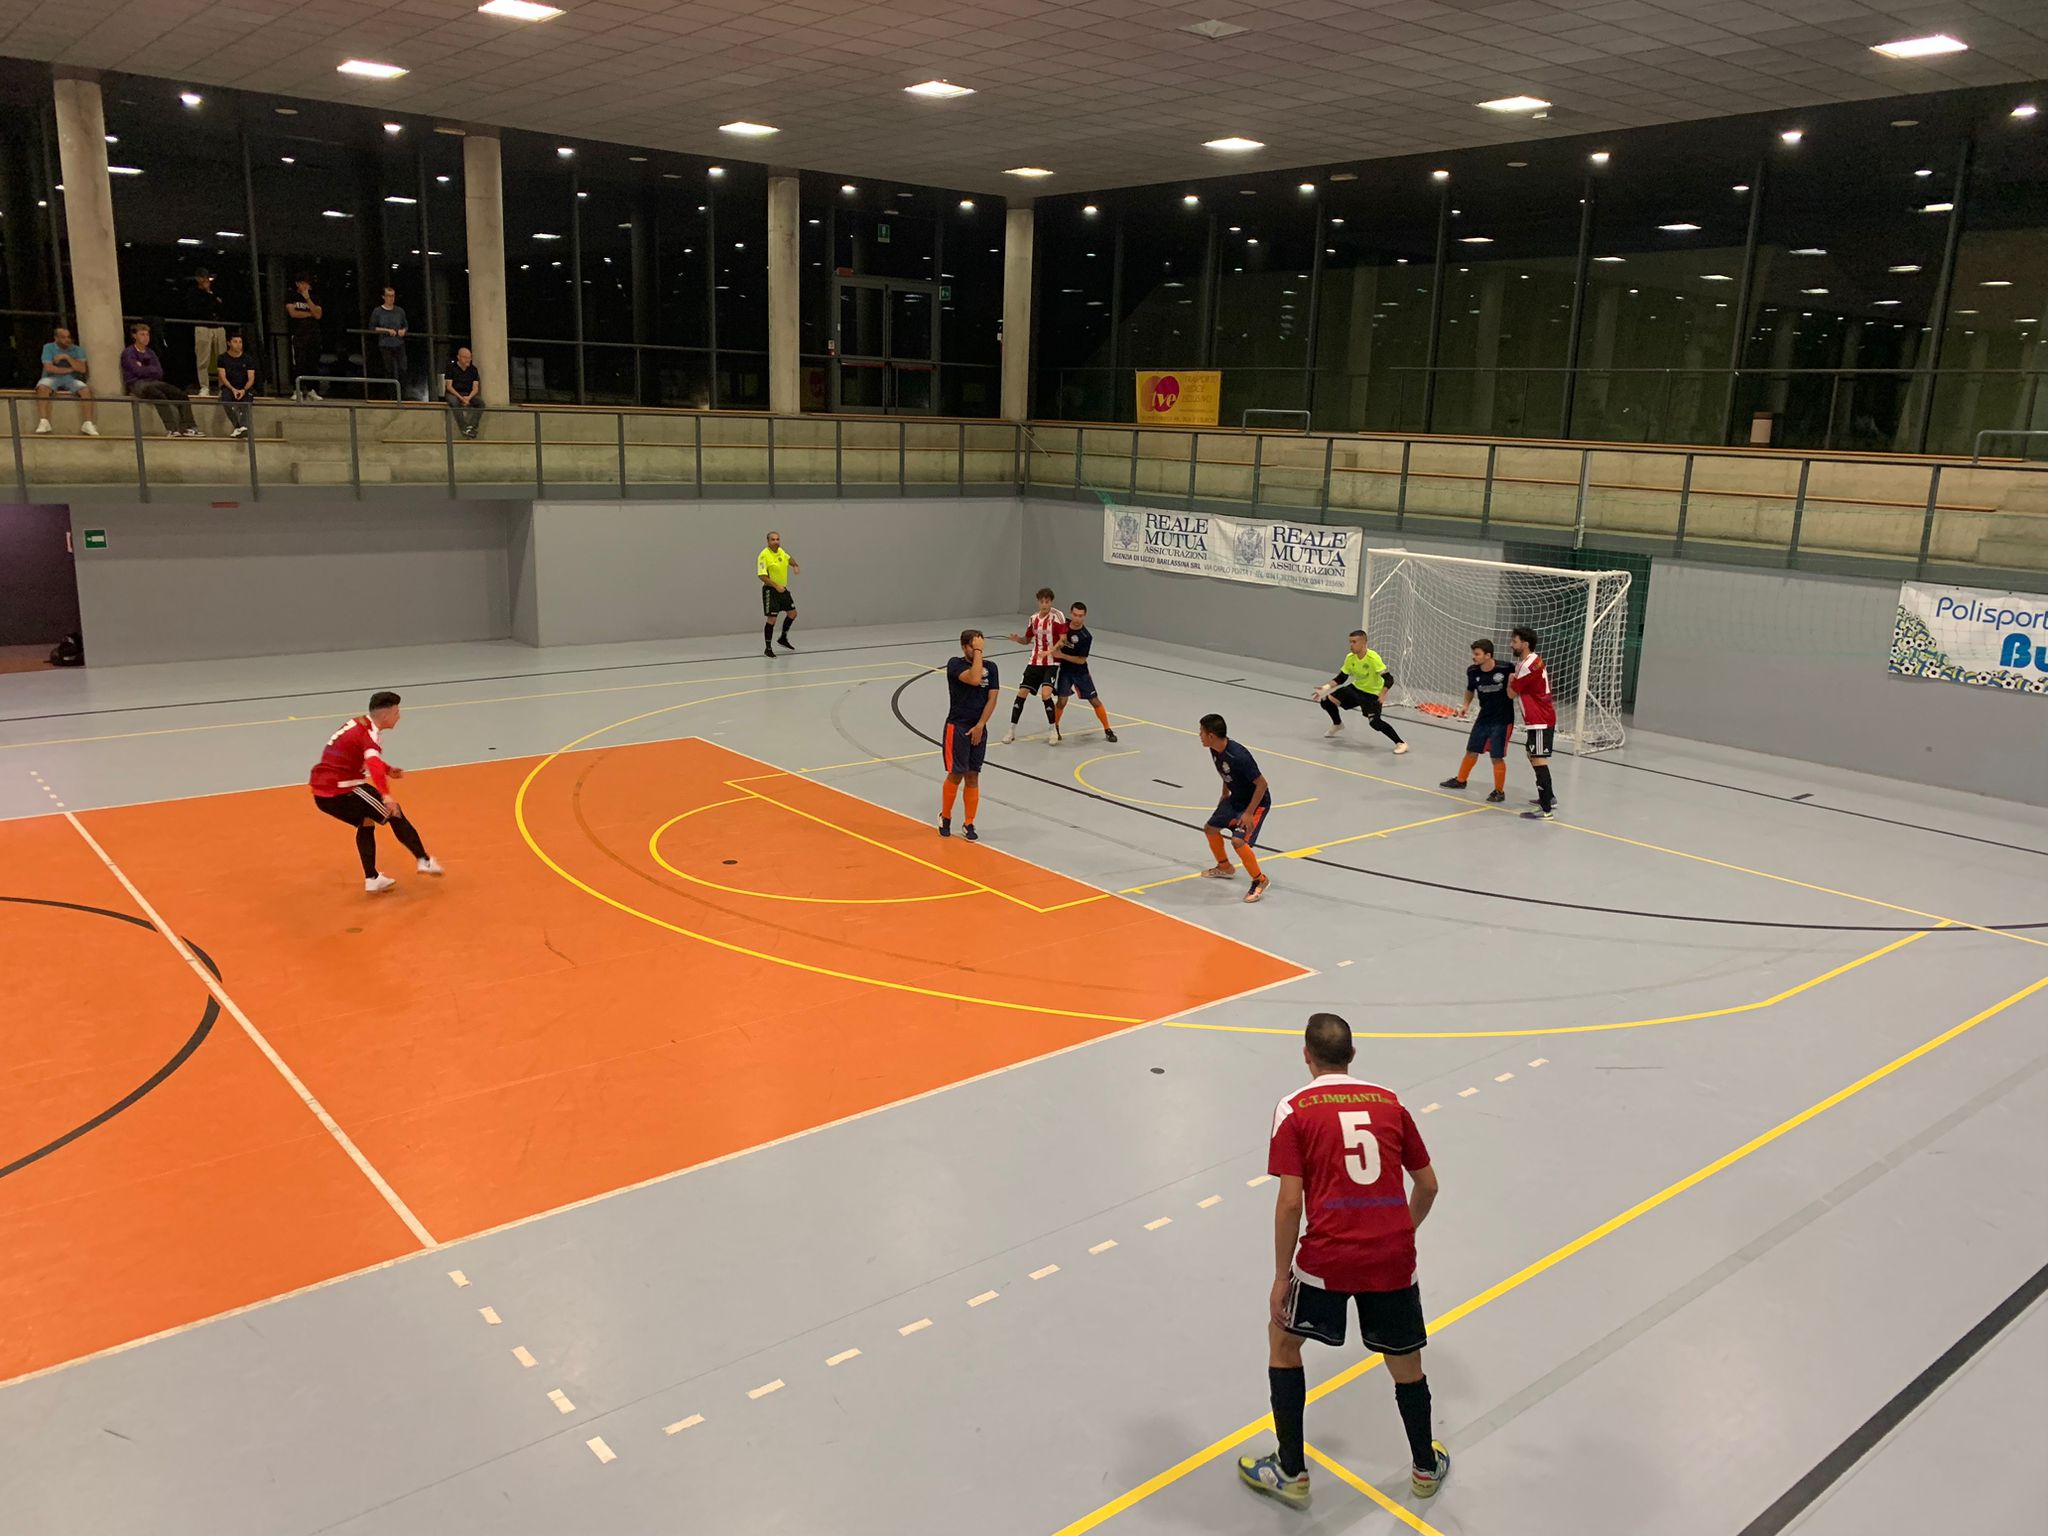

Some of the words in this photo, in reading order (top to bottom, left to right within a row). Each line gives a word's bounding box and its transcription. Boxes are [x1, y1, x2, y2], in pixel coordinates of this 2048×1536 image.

[1146, 514, 1208, 534] REALE
[1145, 530, 1208, 551] MUTUA
[1272, 526, 1347, 549] REALE
[1112, 552, 1132, 561] AGENZIA
[1133, 554, 1140, 562] DI
[1156, 557, 1190, 568] BARLASSINA
[1190, 562, 1201, 570] SRL
[1204, 563, 1213, 571] VIA
[1213, 565, 1231, 574] CARLO
[1231, 567, 1249, 576] PORTA
[1144, 546, 1207, 560] ASSICURAZIONI
[1271, 544, 1346, 567] MUTUA
[1270, 562, 1345, 577] ASSICURAZIONI
[1338, 1110, 1381, 1185] 5
